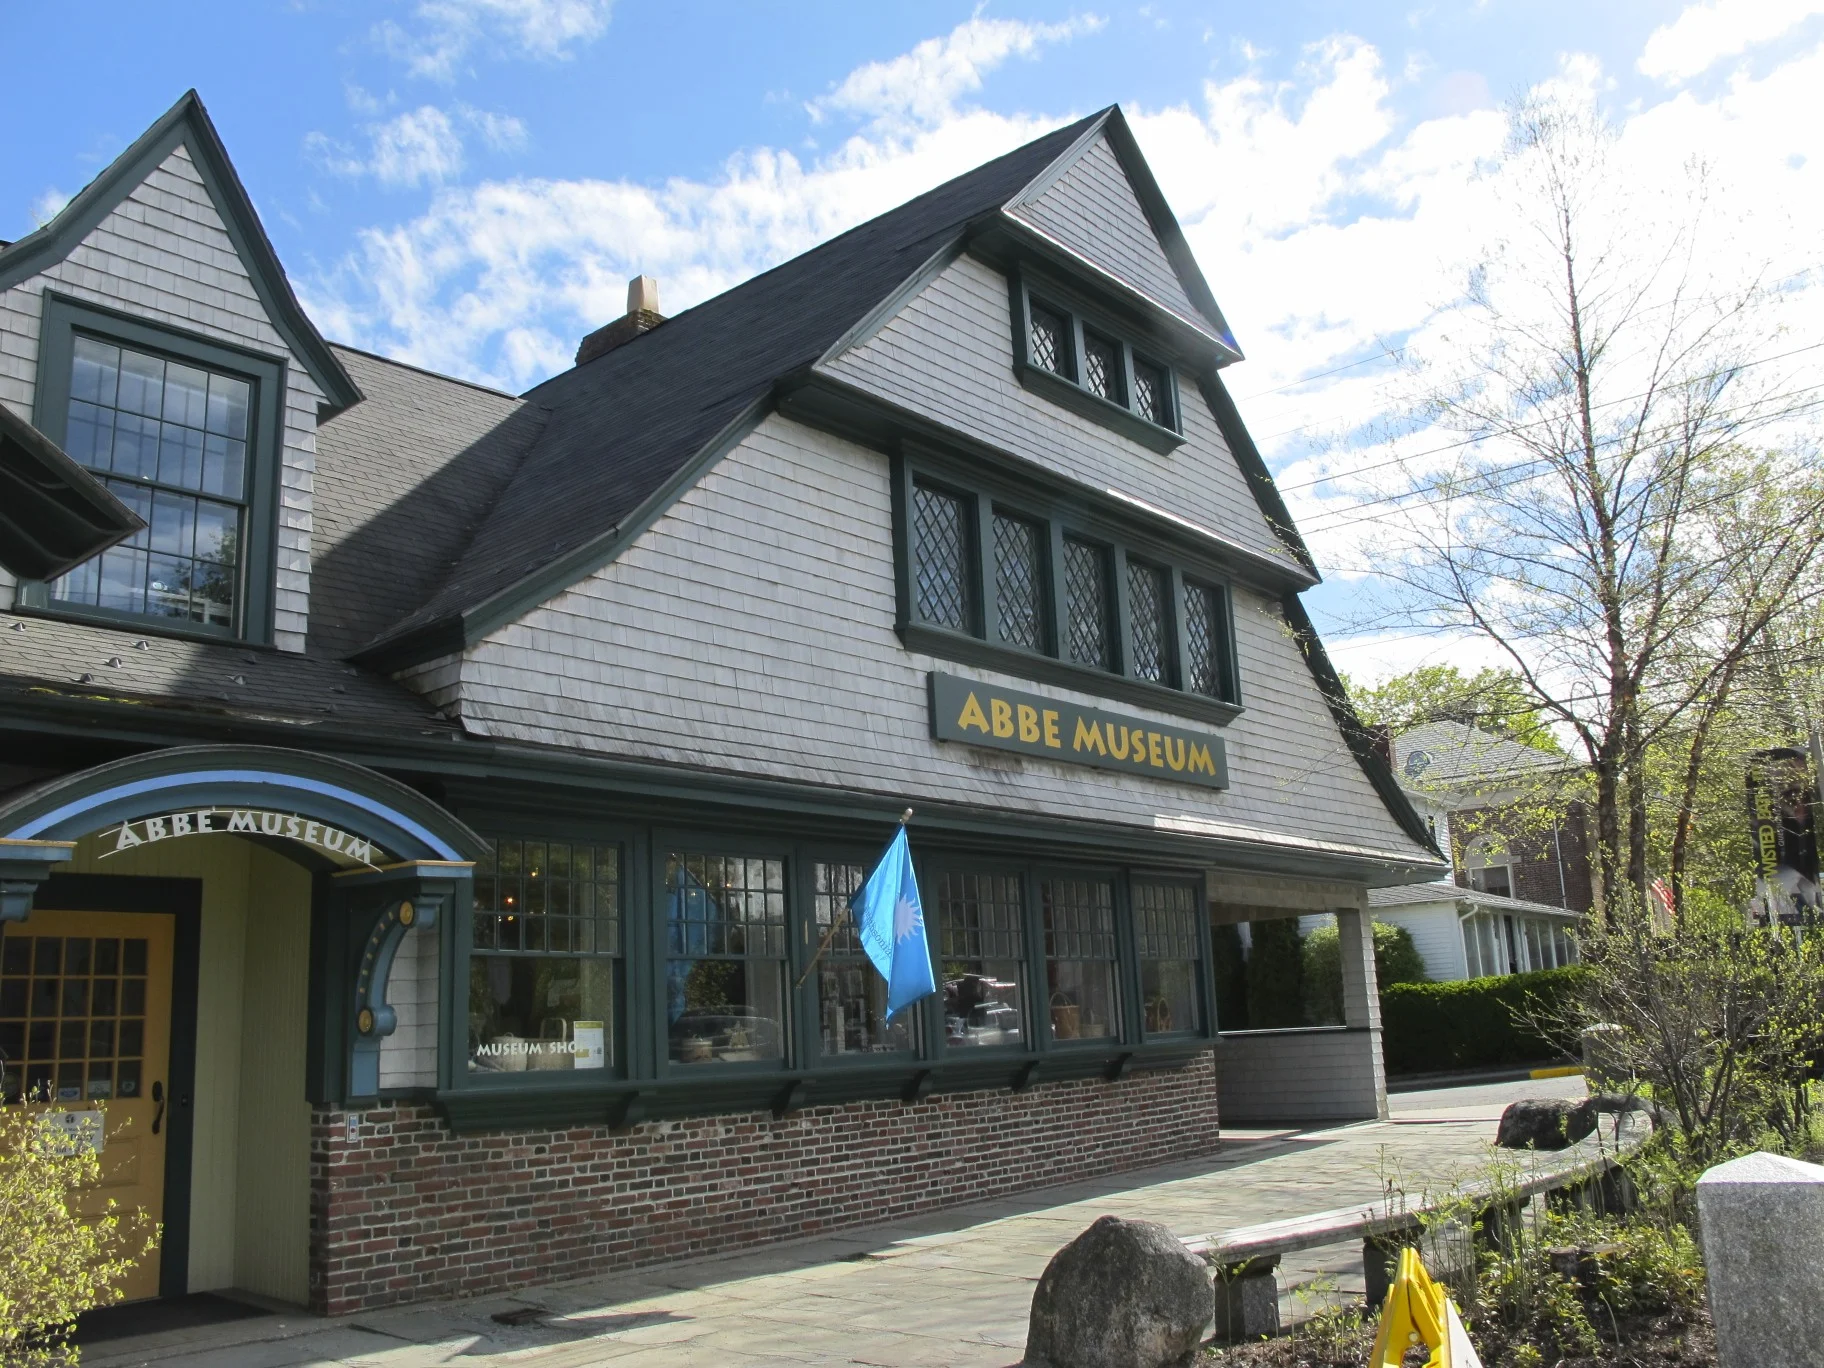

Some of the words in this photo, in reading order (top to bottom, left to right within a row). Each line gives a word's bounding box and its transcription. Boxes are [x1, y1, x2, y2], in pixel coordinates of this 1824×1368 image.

[957, 691, 1061, 748] ABBE
[1073, 716, 1216, 776] MUSEUM
[116, 810, 212, 850] ABBE
[227, 810, 371, 864] MUSEUM
[476, 1042, 543, 1056] MUSEUM
[549, 1040, 584, 1054] SHO
